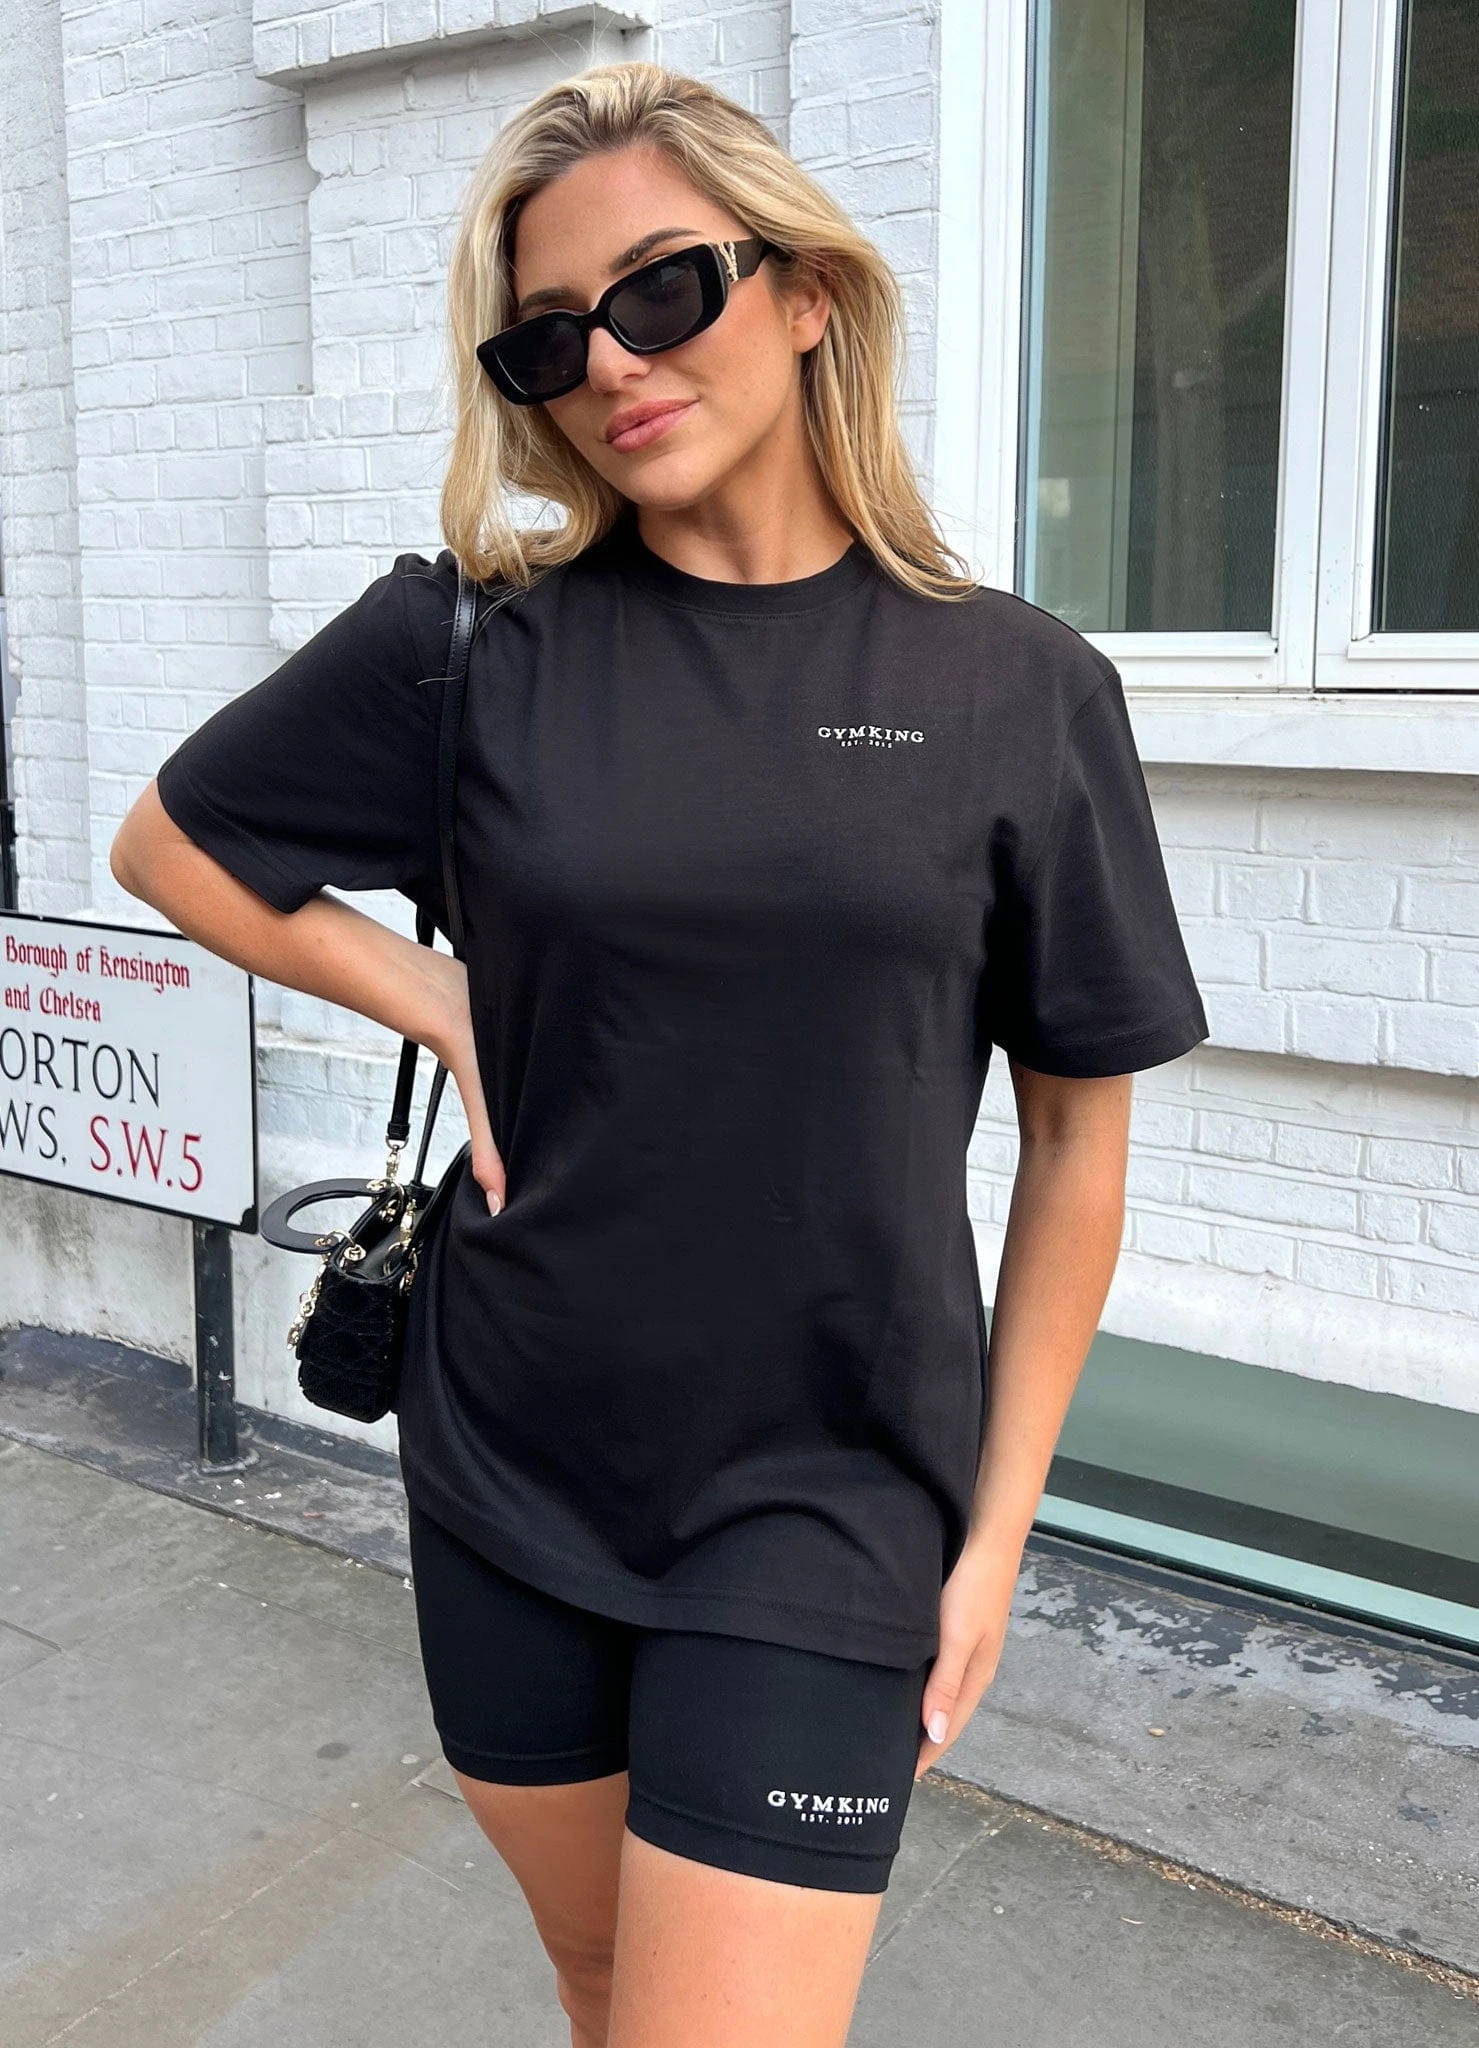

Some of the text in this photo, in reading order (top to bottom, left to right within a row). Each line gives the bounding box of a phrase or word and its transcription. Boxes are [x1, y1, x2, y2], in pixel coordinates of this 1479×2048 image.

[818, 725, 925, 743] GYMKING
[5, 935, 190, 993] Borough of Kensington
[5, 982, 102, 1023] and Chelsea
[89, 1115, 204, 1192] S.W.5
[767, 1790, 889, 1814] GYMKING
[801, 1813, 830, 1824] EST.
